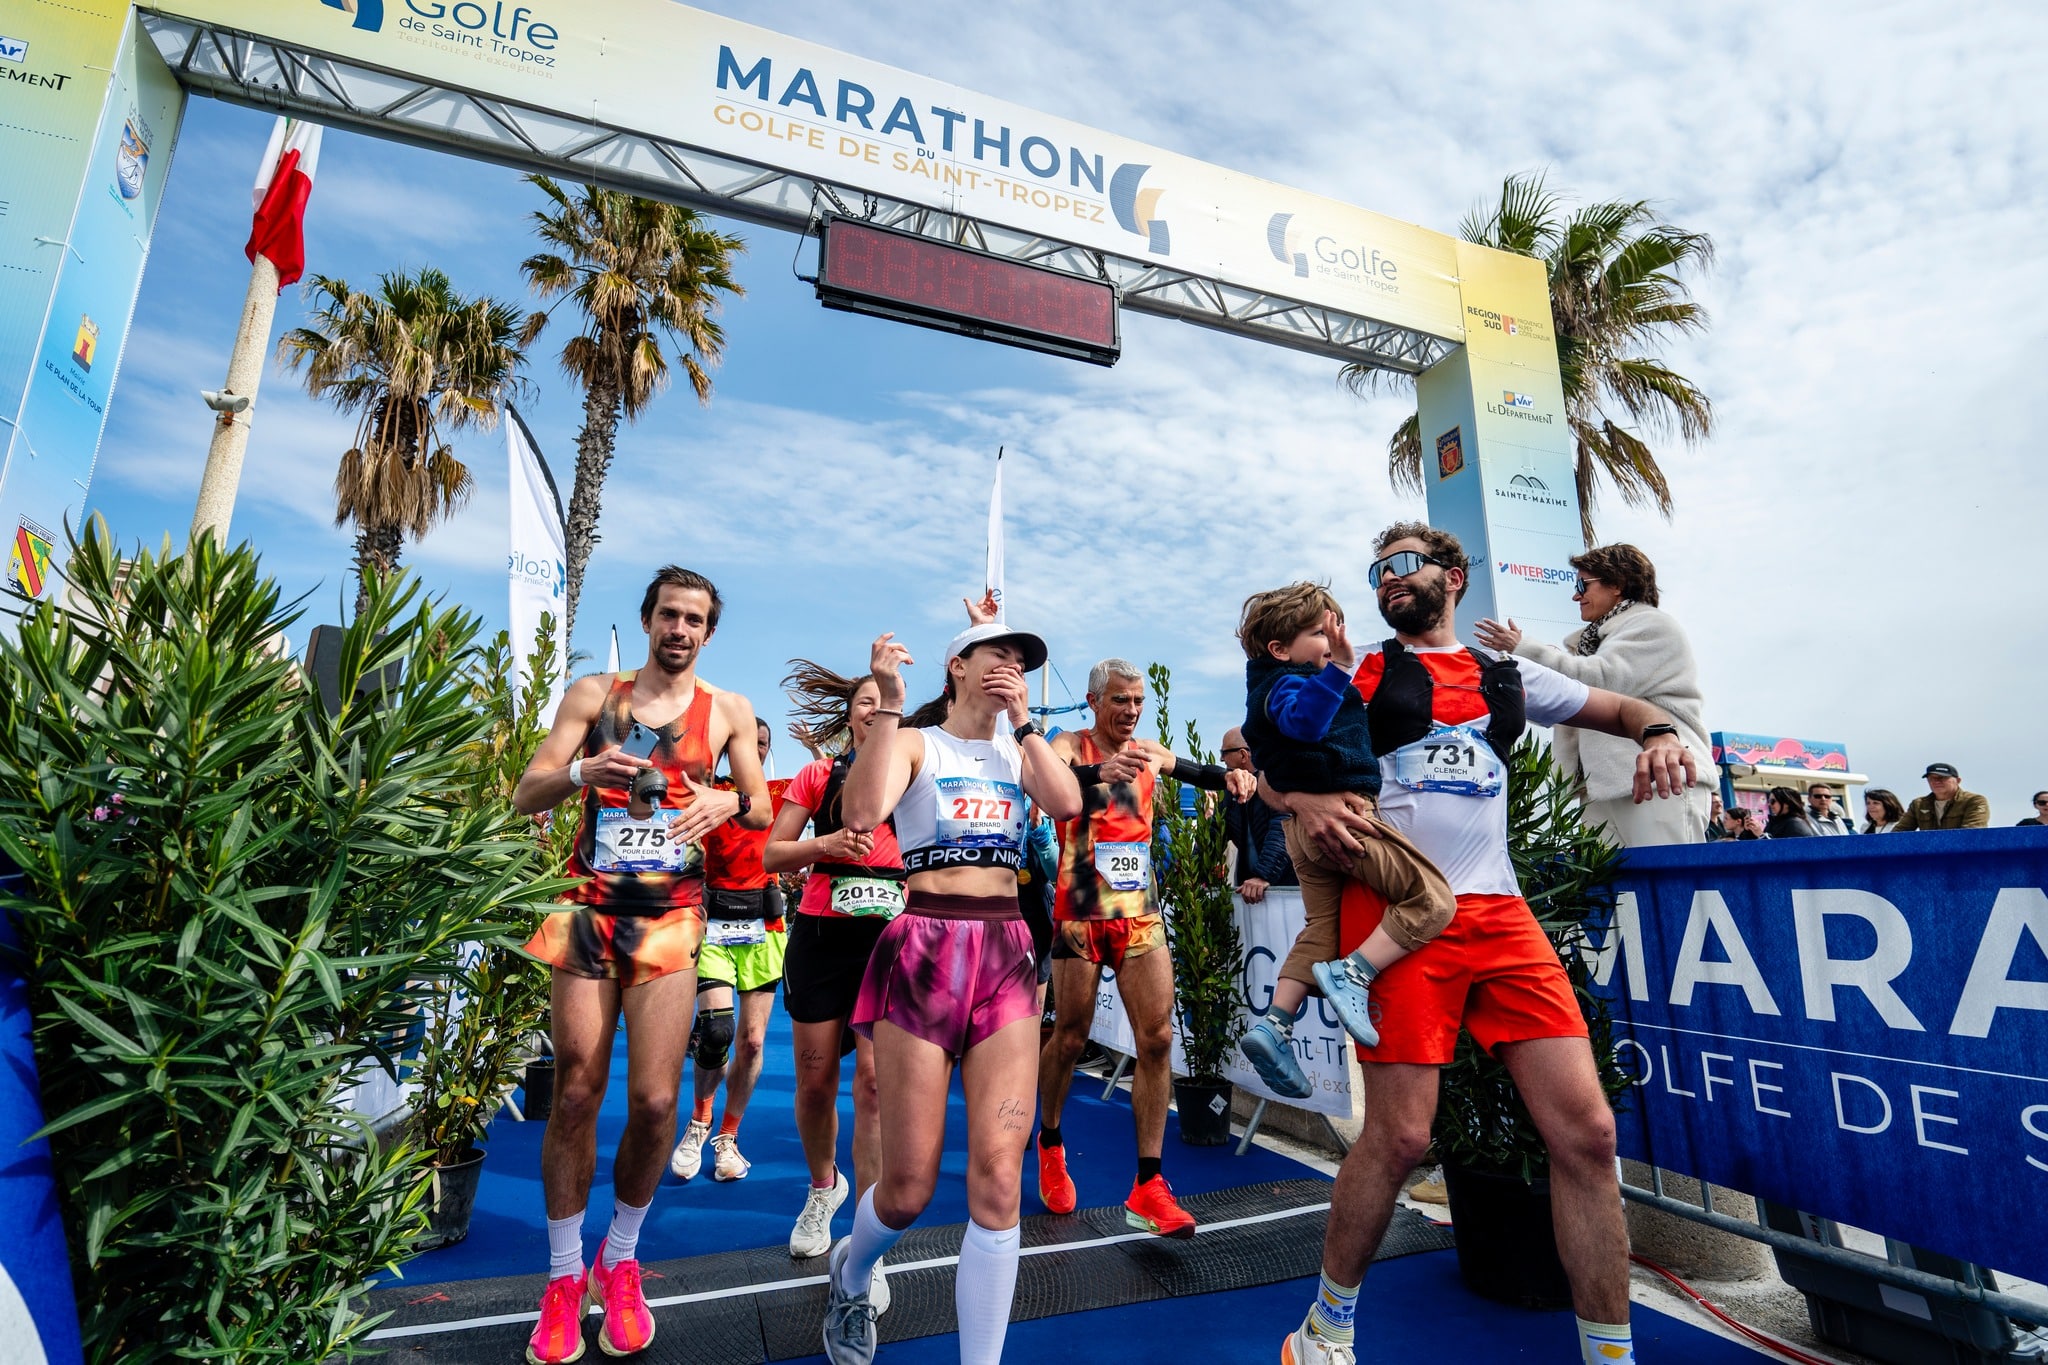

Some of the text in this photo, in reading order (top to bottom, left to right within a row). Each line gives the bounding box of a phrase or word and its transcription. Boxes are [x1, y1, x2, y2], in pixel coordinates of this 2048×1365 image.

[399, 16, 556, 68] de Saint Tropez
[396, 31, 554, 80] Territoire d'exception
[716, 44, 1104, 194] MARATHON
[713, 104, 1106, 224] GOLFE DE SAINT-TROPEZ
[916, 147, 935, 160] DU
[1314, 235, 1398, 281] Golfe
[1316, 263, 1331, 276] de
[1333, 266, 1361, 284] Saint
[1363, 274, 1400, 295] Tropez
[1467, 306, 1501, 322] REGION
[1484, 320, 1502, 331] SUD
[45, 359, 103, 415] LE PLAN DE LA TOUR
[1495, 488, 1568, 507] SAINTE-MAXIME
[1423, 744, 1476, 768] 731
[1433, 767, 1468, 775] CLEMICH
[602, 811, 630, 819] MARAT
[952, 797, 1012, 820] 2727
[617, 827, 666, 848] 275
[903, 852, 924, 873] KE
[928, 848, 982, 866] PRO
[1110, 856, 1139, 872] 298
[838, 886, 899, 903] 20127
[1097, 991, 1114, 1011] pez
[997, 1098, 1028, 1119] Eden
[1612, 1038, 1793, 1120] OLFE
[1830, 1070, 1970, 1157] DE
